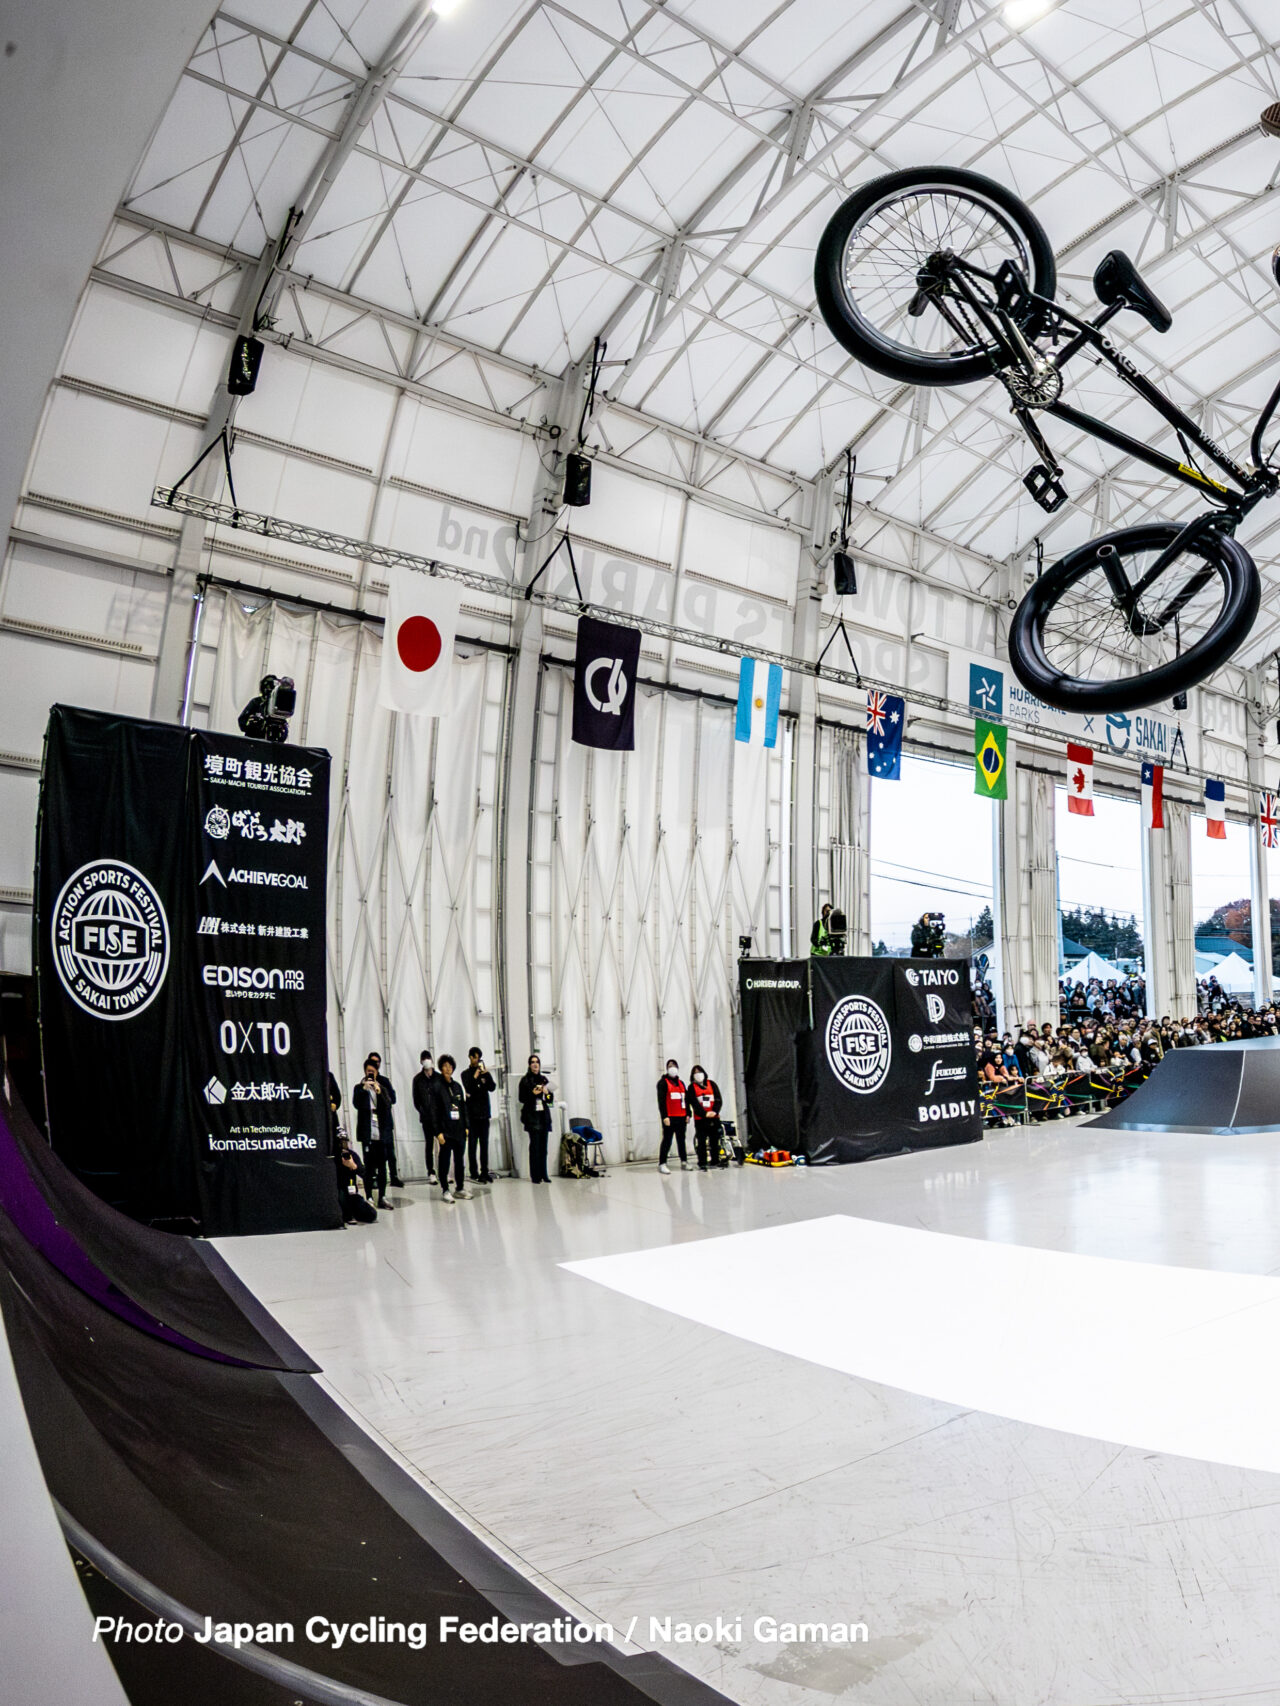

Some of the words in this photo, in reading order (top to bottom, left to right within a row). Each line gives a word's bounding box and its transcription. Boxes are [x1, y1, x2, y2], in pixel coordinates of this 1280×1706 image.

[1009, 704, 1040, 724] PARKS
[1135, 716, 1167, 753] SAKAI
[204, 754, 314, 788] 境町観光協会
[209, 776, 246, 788] SAKAI-MACHI
[247, 781, 269, 791] TOURIST
[269, 785, 306, 796] ASSOCIATION
[227, 867, 309, 890] ACHIEVEGOAL
[59, 883, 85, 941] ACTION
[83, 869, 131, 891] SPORTS
[129, 881, 163, 948] FESTIVAL
[220, 921, 256, 936] 株式会社
[83, 924, 138, 957] FISE
[919, 969, 960, 986] TAIYO
[75, 978, 111, 1010] SAKAI
[112, 982, 148, 1010] TOWN
[830, 1011, 843, 1049] ACTION
[841, 1001, 868, 1015] SPORTS
[867, 1006, 888, 1046] FESTIVAL
[845, 1034, 877, 1055] FISE
[843, 1070, 866, 1088] SAKAI
[865, 1067, 883, 1088] TOWN
[230, 1081, 315, 1101] 金太郎ホーム
[918, 1099, 976, 1123] BOLDLY
[229, 1125, 241, 1134] Art
[242, 1126, 250, 1134] in
[250, 1125, 291, 1134] Technology
